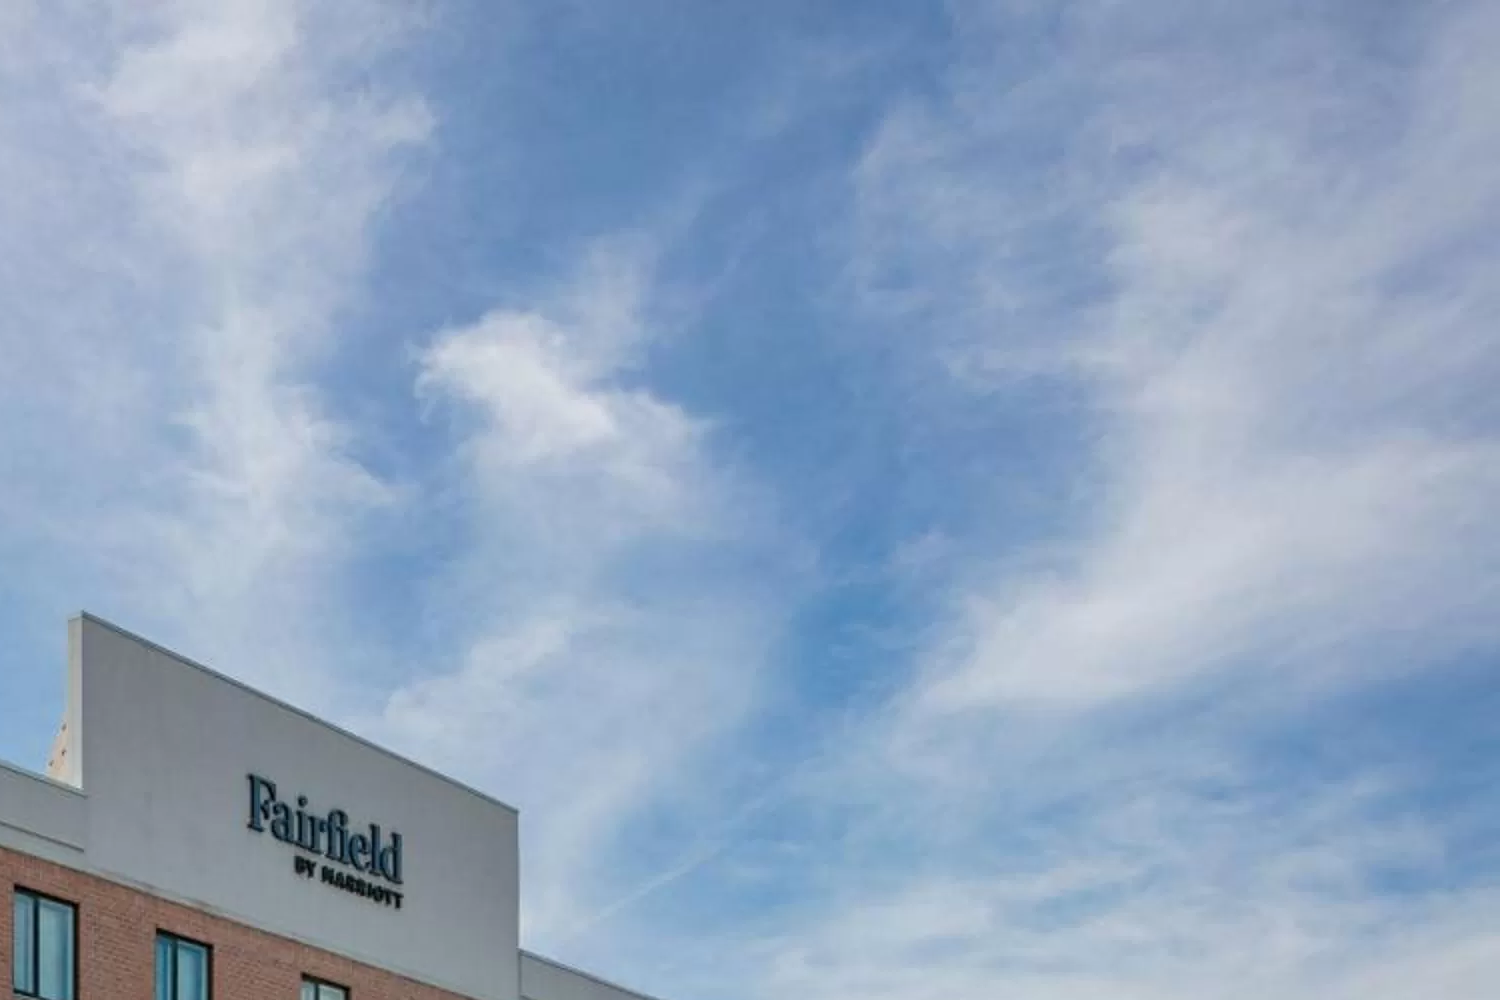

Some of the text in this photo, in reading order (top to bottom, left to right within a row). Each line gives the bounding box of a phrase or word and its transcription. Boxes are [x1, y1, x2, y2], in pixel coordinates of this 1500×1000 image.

[247, 773, 403, 884] Fairfield
[294, 855, 404, 909] BY MARRIOTT
